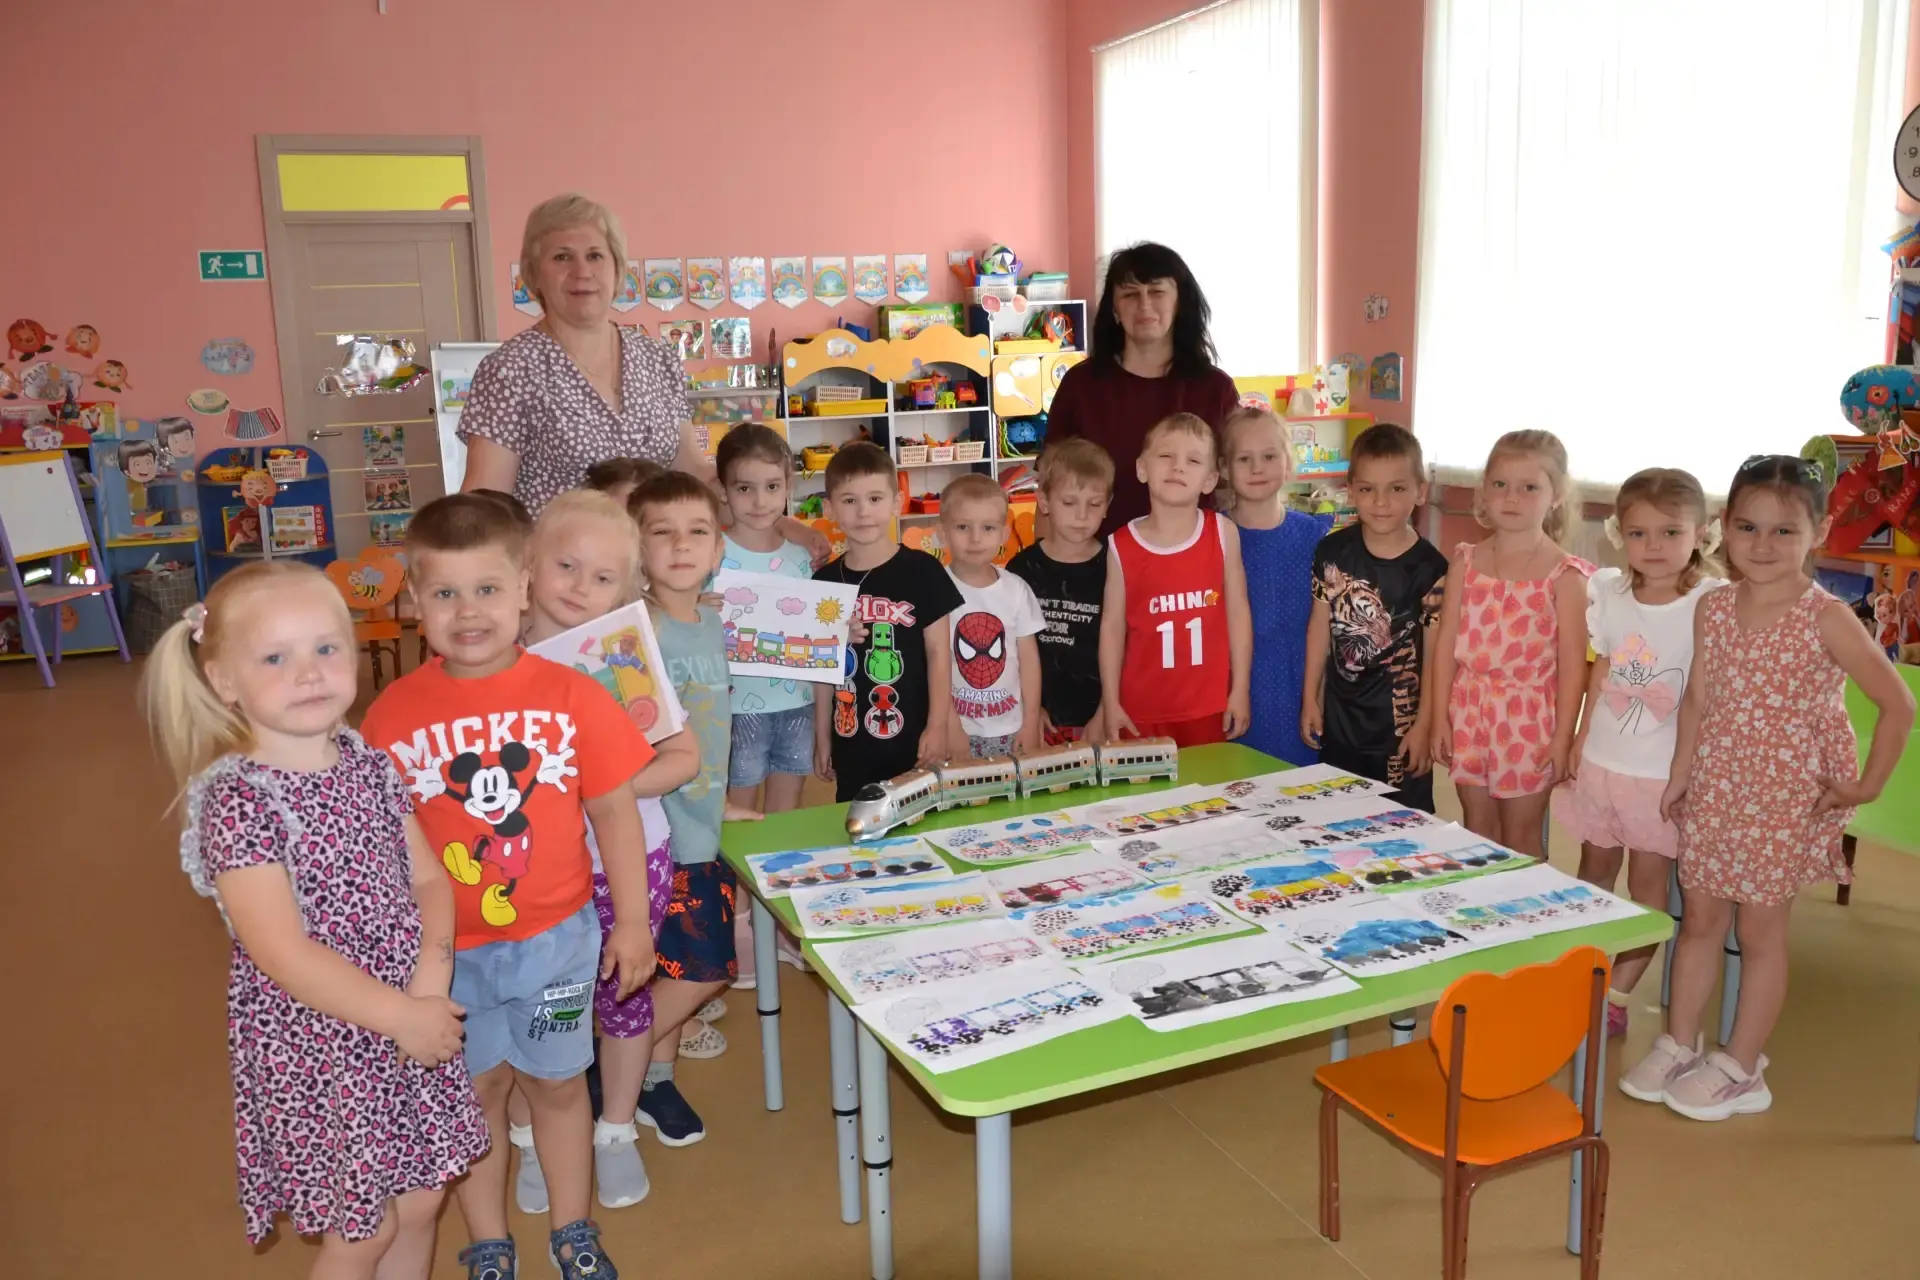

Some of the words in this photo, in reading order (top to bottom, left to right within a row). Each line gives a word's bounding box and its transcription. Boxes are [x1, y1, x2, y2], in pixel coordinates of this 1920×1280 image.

[1909, 146, 1918, 158] 9
[853, 594, 916, 627] BLOX
[1038, 598, 1060, 608] N'T
[1062, 601, 1100, 613] TRADE
[1156, 616, 1203, 668] 11
[958, 688, 1010, 702] AMAZING
[389, 710, 577, 770] MICKEY
[533, 1004, 552, 1021] IS
